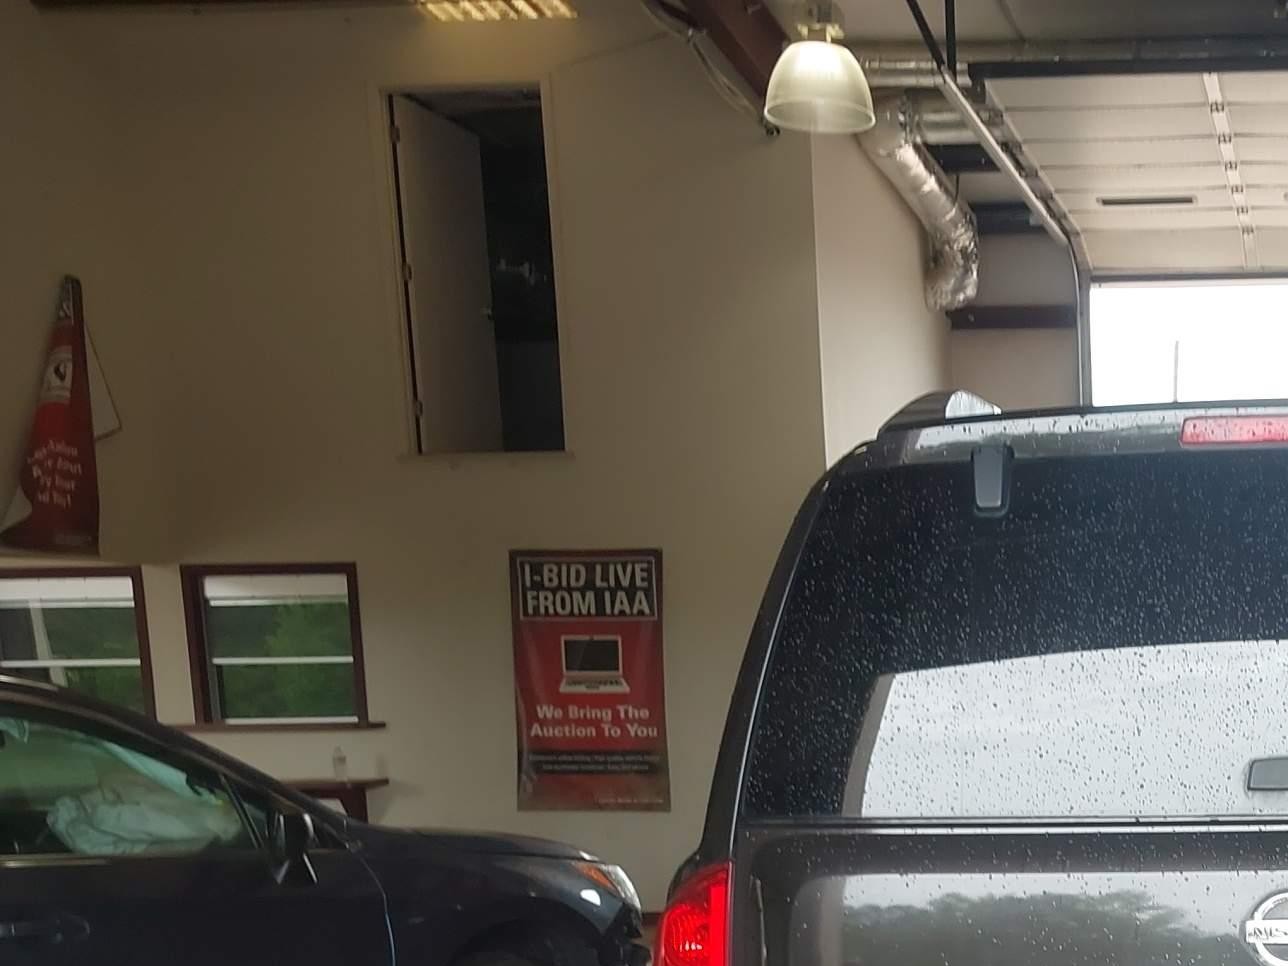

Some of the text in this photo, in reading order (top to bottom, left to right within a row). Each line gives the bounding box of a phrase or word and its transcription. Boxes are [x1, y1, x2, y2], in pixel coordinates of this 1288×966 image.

[524, 563, 648, 588] I-BID LIVE
[527, 591, 650, 615] FROM IAA
[536, 705, 649, 722] We Bring The
[530, 723, 657, 737] Auction To You
